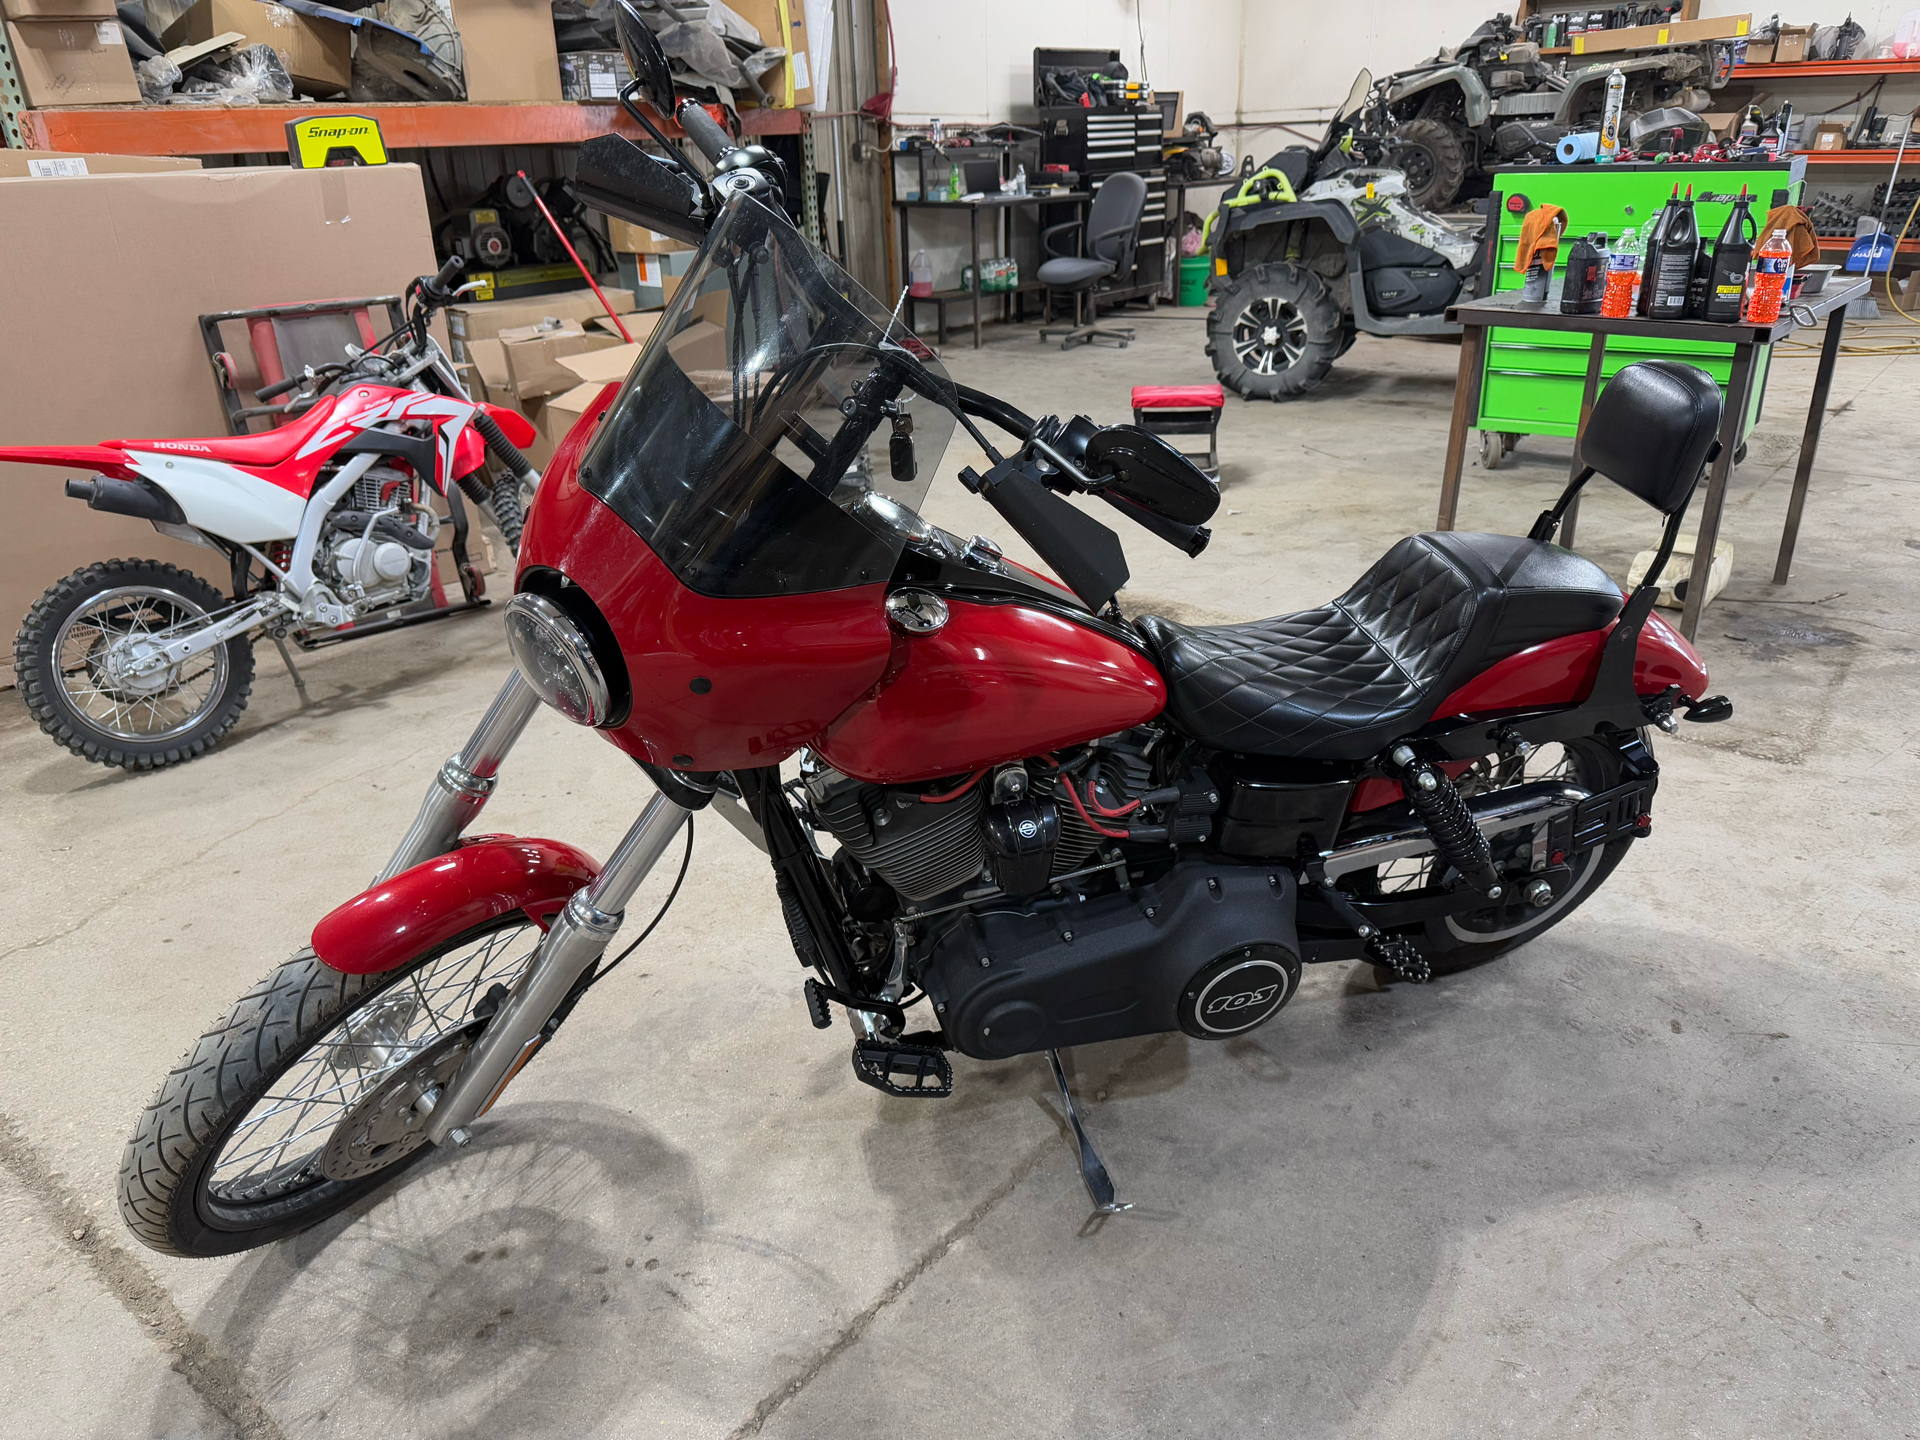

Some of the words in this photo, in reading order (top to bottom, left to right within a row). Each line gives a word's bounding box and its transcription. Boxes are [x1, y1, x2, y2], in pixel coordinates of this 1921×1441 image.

[307, 126, 370, 139] Snap-on
[152, 441, 213, 453] HONDA
[71, 629, 97, 639] INSIDE
[1206, 984, 1279, 1014] 103
